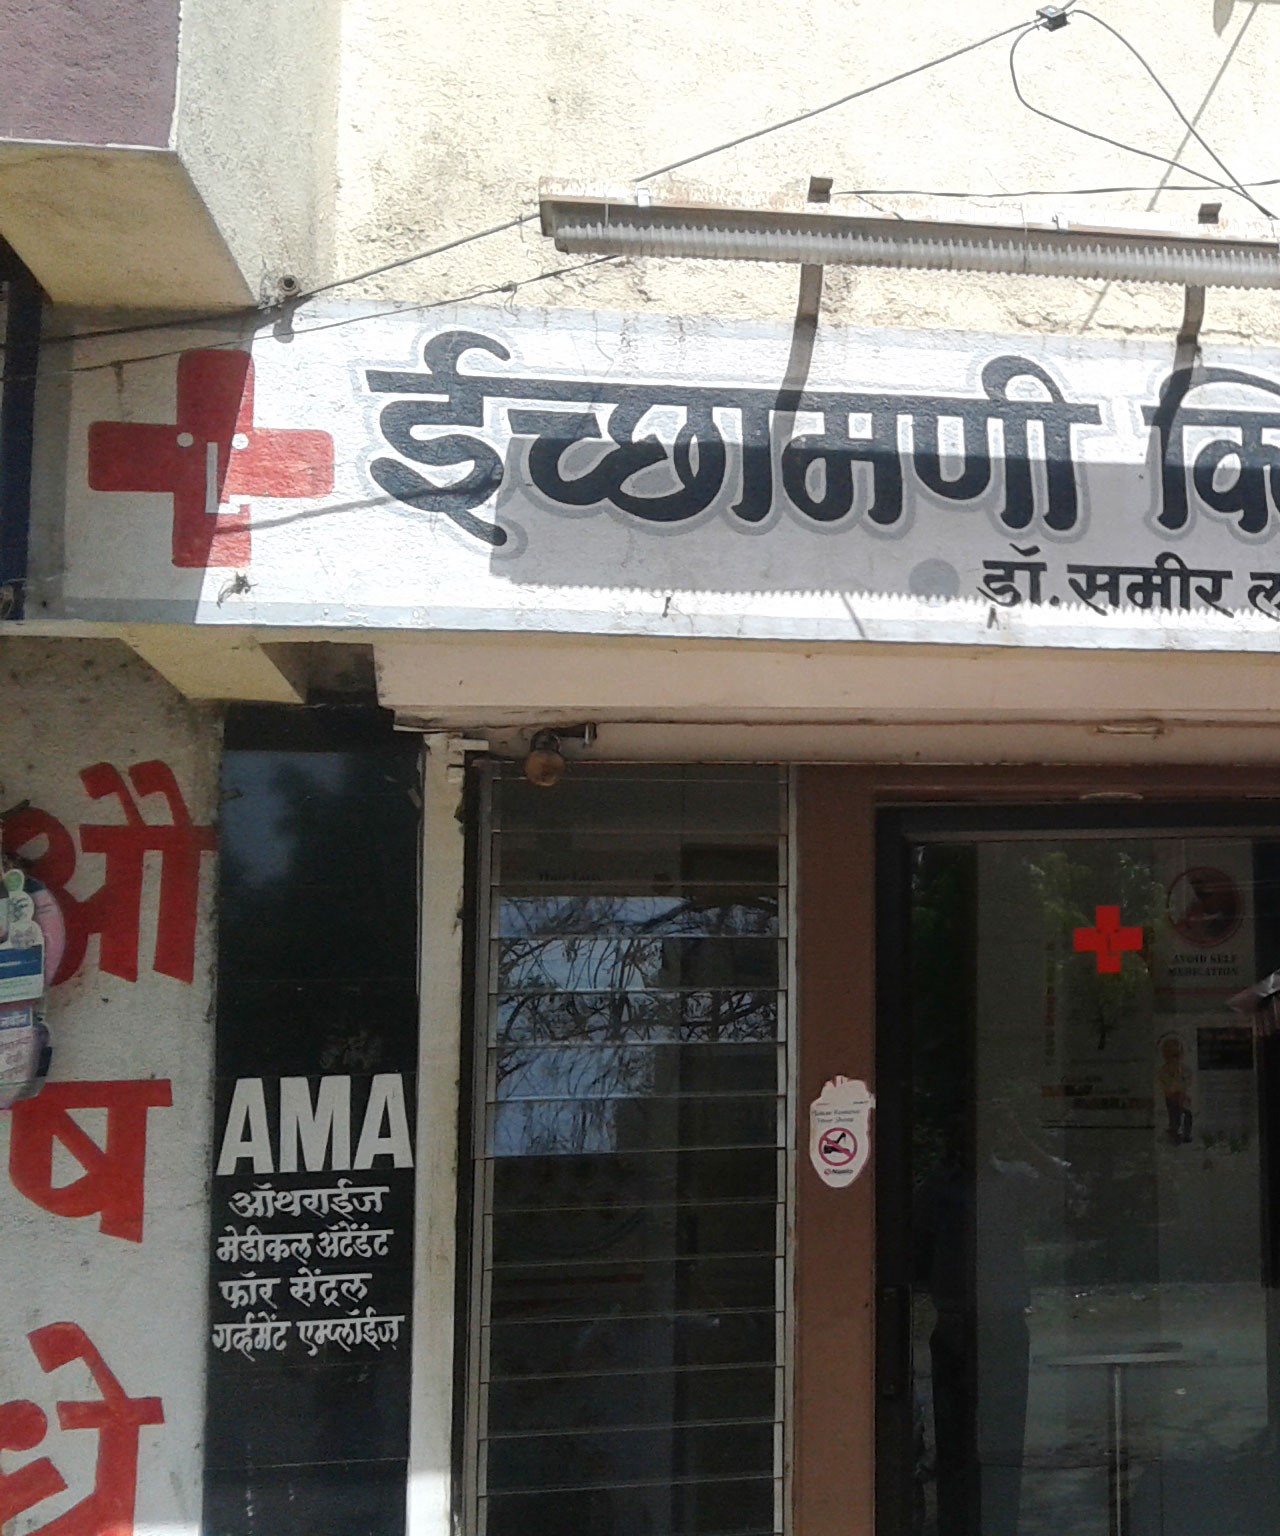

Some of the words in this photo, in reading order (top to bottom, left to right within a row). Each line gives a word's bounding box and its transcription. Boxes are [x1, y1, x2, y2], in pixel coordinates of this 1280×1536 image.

[366, 330, 1100, 546] ईच्छामणी
[1067, 551, 1234, 617] समीर
[216, 1073, 415, 1175] AMA
[216, 1225, 315, 1265] मेडीकल
[218, 1271, 282, 1310] फॉर
